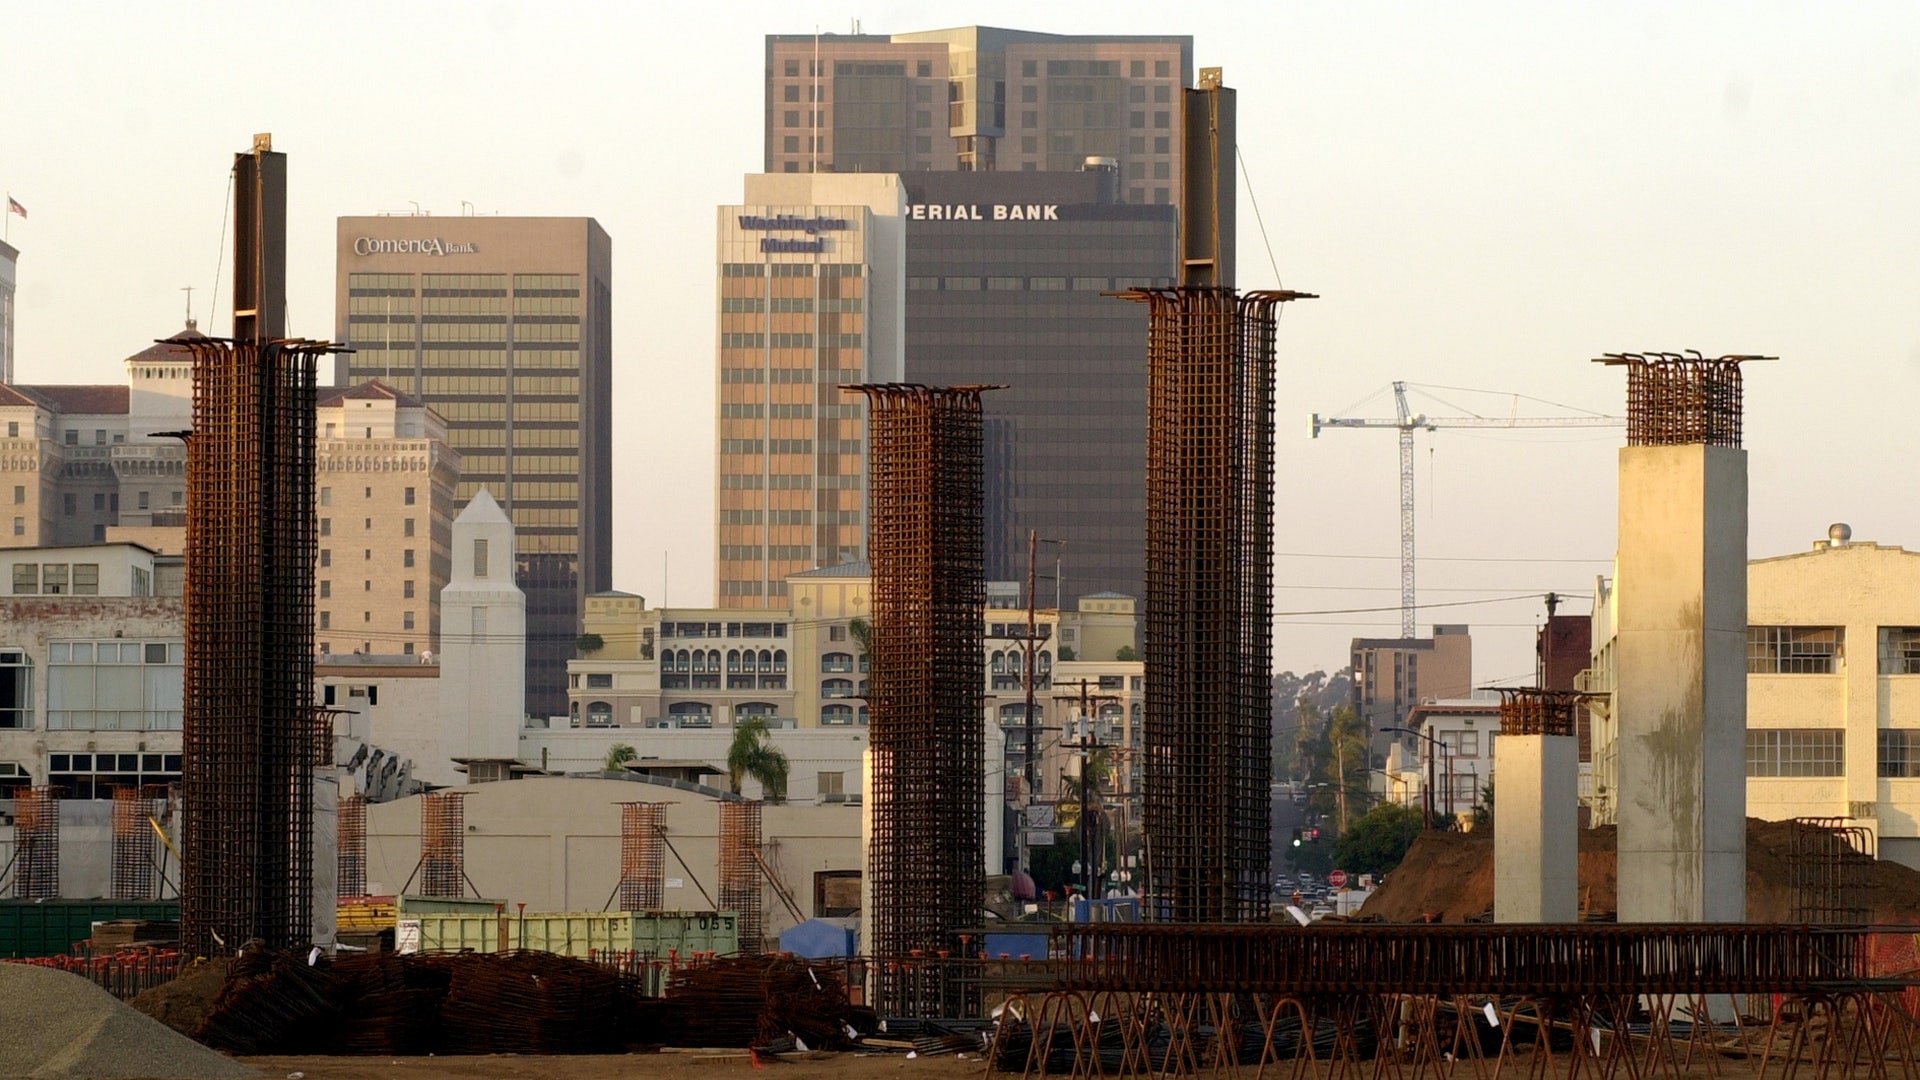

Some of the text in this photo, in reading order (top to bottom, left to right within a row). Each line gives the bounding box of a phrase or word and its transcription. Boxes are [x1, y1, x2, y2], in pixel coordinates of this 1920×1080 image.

[993, 204, 1058, 220] BANK
[738, 214, 846, 235] Washington
[445, 242, 474, 253] Bank
[760, 237, 824, 253] Mutual
